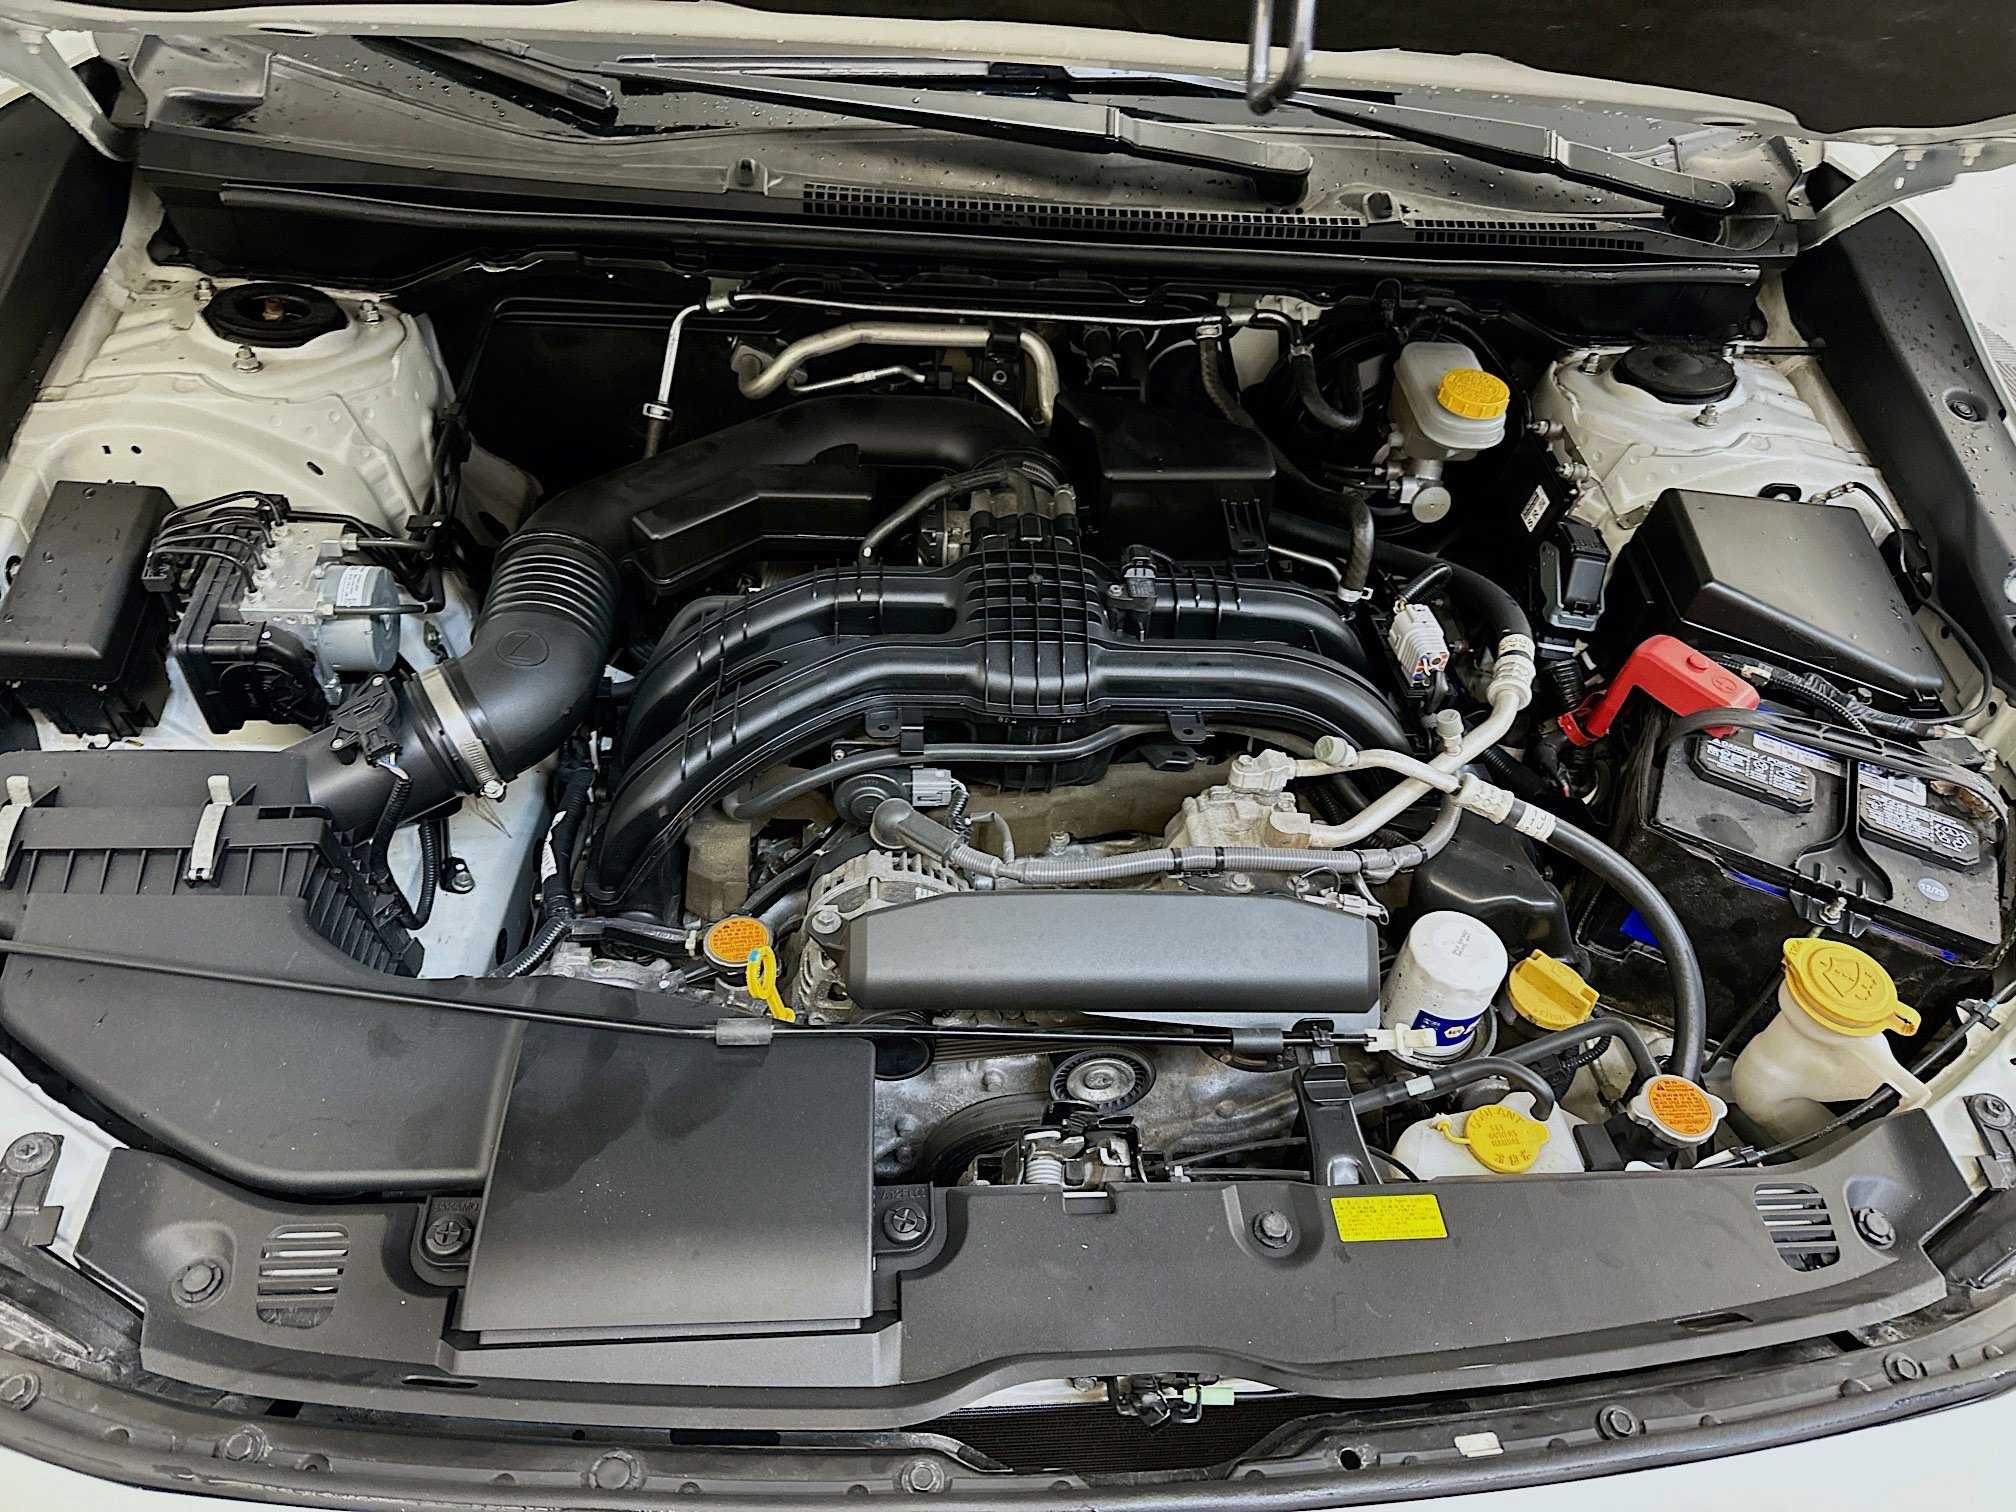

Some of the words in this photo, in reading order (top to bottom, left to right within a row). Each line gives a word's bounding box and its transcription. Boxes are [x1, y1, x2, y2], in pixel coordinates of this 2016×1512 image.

[1720, 739, 1760, 758] DANGER
[1766, 756, 1802, 773] POISON
[1471, 1107, 1524, 1130] COOLANT
